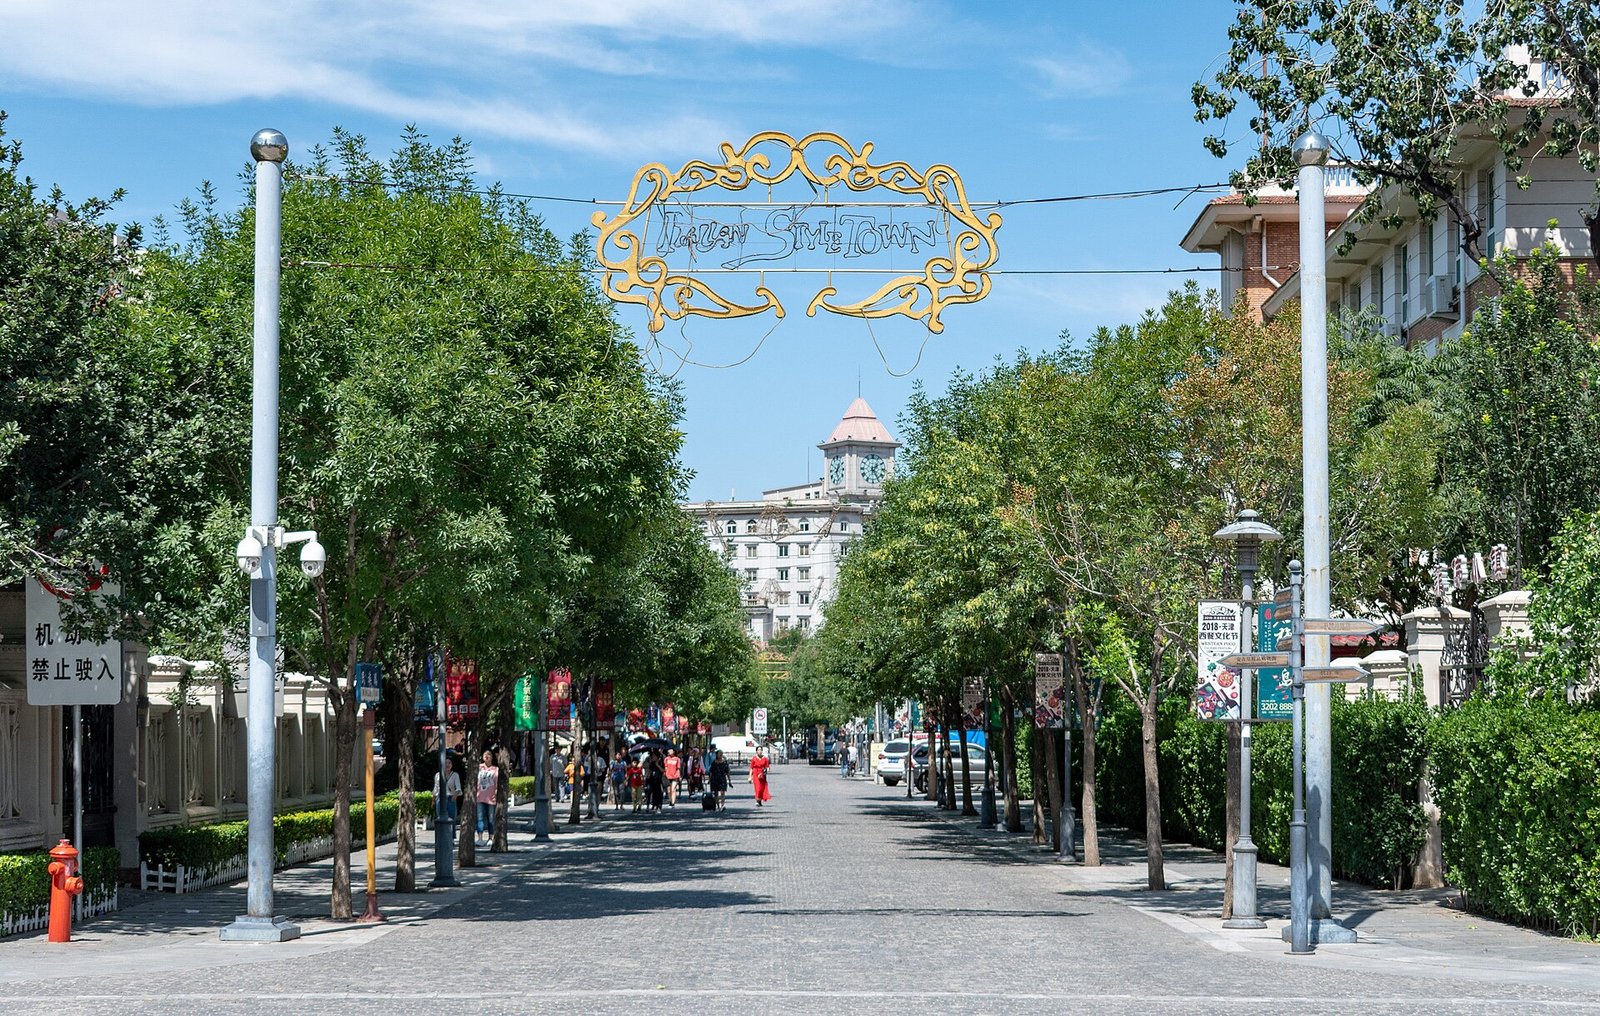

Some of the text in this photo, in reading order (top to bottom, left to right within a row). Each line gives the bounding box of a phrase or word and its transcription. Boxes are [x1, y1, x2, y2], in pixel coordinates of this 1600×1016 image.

[839, 214, 937, 258] TOWN
[1199, 632, 1238, 640] 西餐文化节
[32, 658, 114, 681] 禁止驶入
